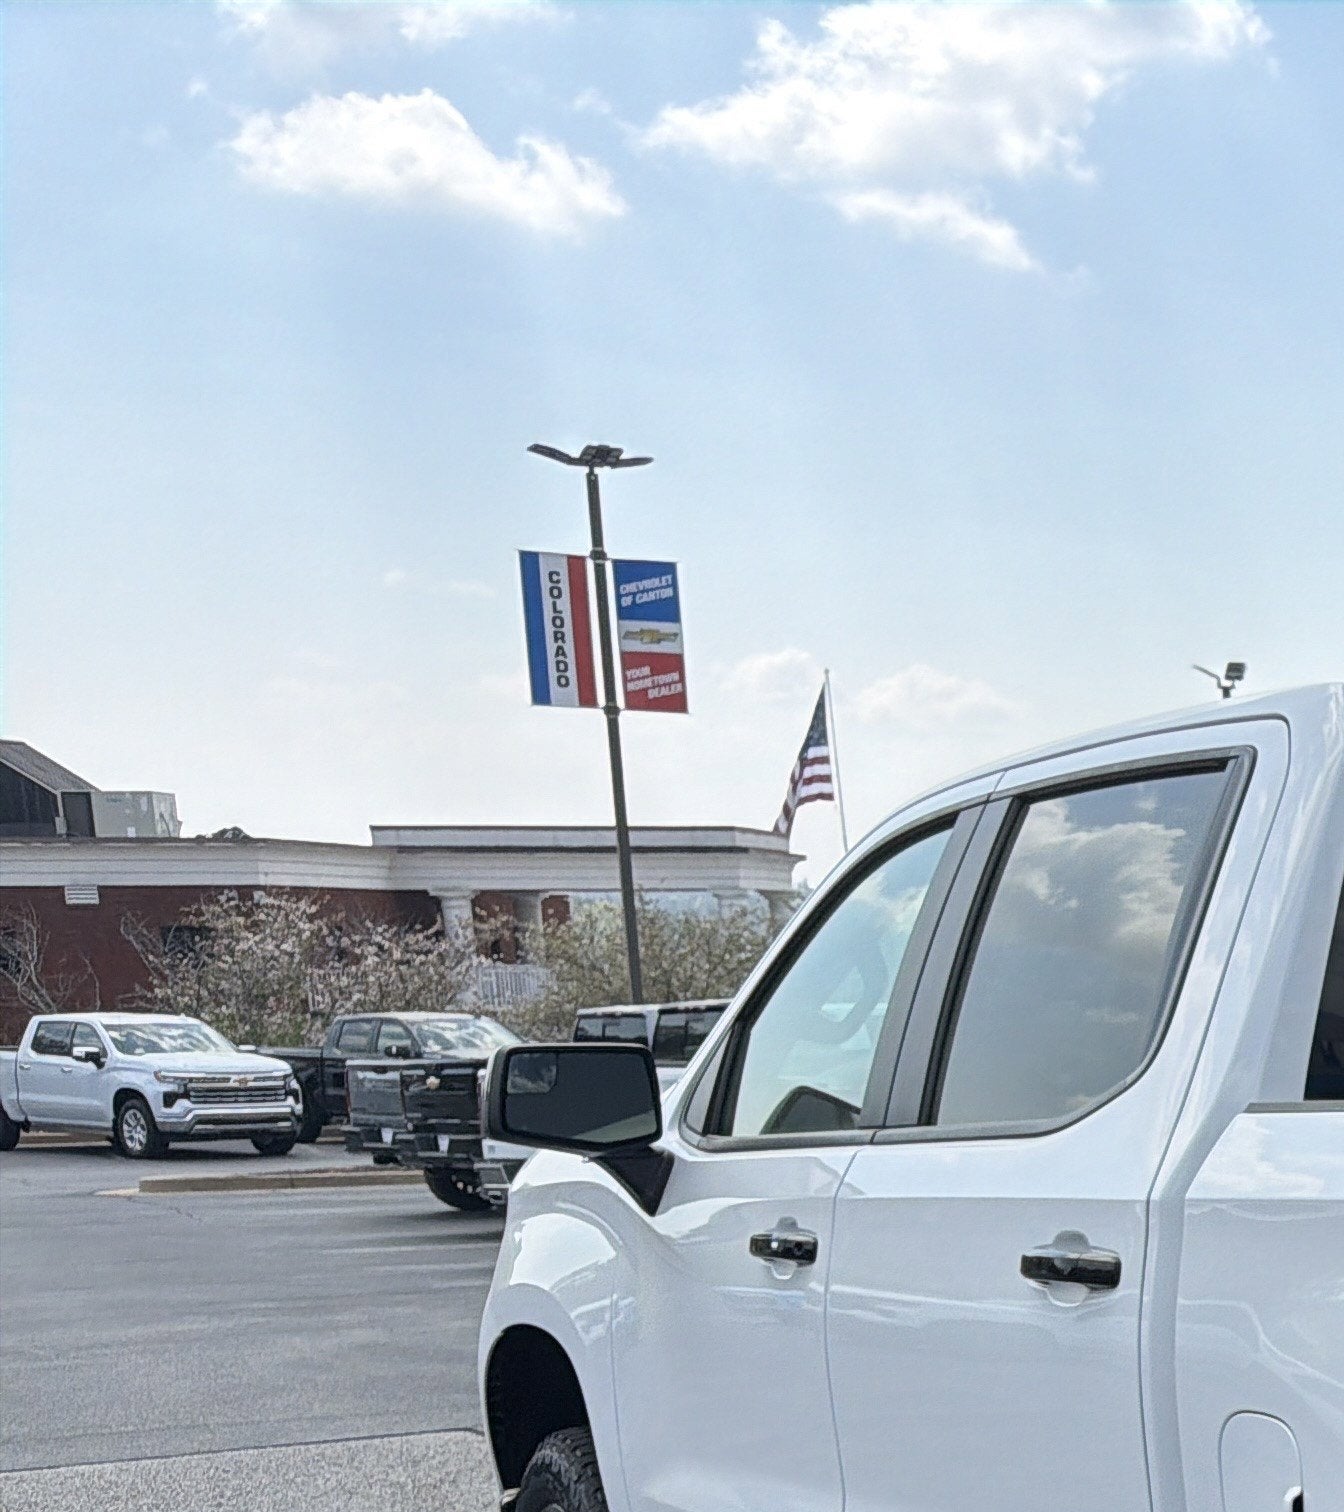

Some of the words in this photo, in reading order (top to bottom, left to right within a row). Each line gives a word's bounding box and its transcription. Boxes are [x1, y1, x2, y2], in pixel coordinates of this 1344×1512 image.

[620, 574, 672, 595] CHEVROLET
[620, 595, 633, 607] OF
[635, 587, 673, 604] CANTON
[548, 570, 570, 688] COLORADO
